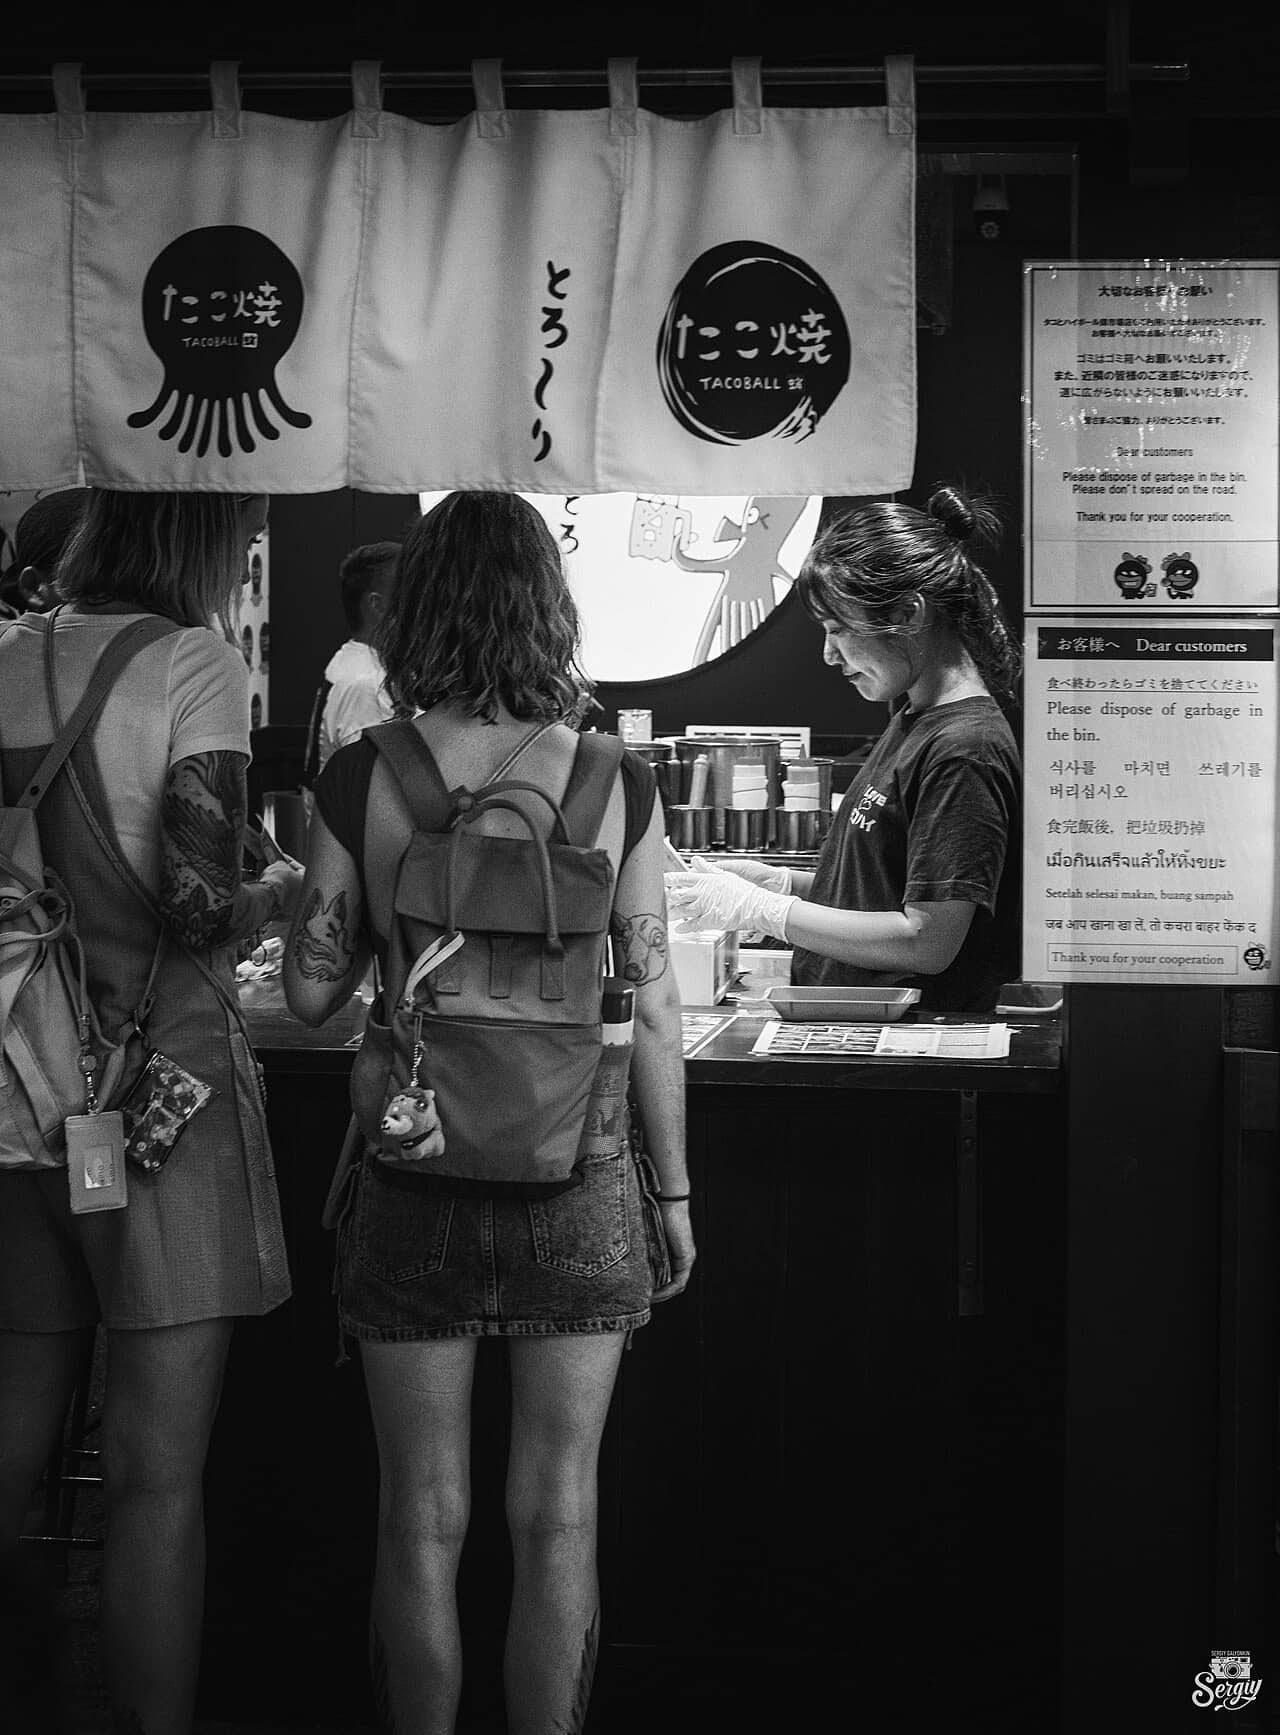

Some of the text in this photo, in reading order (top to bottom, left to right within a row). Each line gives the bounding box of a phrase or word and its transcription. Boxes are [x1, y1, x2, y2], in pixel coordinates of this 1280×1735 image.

[161, 281, 283, 328] たこ焼
[182, 336, 239, 347] TACOBALL
[676, 307, 833, 364] たこ焼
[699, 376, 781, 391] TACOBALL
[1116, 446, 1194, 457] Dear customers
[1062, 472, 1248, 485] Please dispose of garbage in the bin.
[1072, 485, 1106, 494] Please
[1140, 485, 1174, 497] spread
[1177, 487, 1190, 495] on
[1192, 485, 1208, 495] the
[1212, 485, 1237, 495] road.
[1076, 512, 1233, 523] Thank you for your cooperation.
[1056, 636, 1248, 653] お客様へ Dear customers
[1047, 676, 1258, 690] 食べ終わったらゴミを捨ててください
[1047, 702, 1264, 719] Please dispose of garbage in
[1047, 728, 1101, 742] the bin.
[1050, 760, 1263, 778] 식사를 마치면 쓰레기를
[1050, 784, 1128, 800] 버리십시오
[1045, 888, 1234, 903] Setelah selesai makan, buang sampah
[1067, 920, 1087, 930] आप
[1090, 920, 1115, 931] खाना
[1163, 921, 1192, 932] कचरा
[1051, 952, 1224, 967] Thank you for your cooperation
